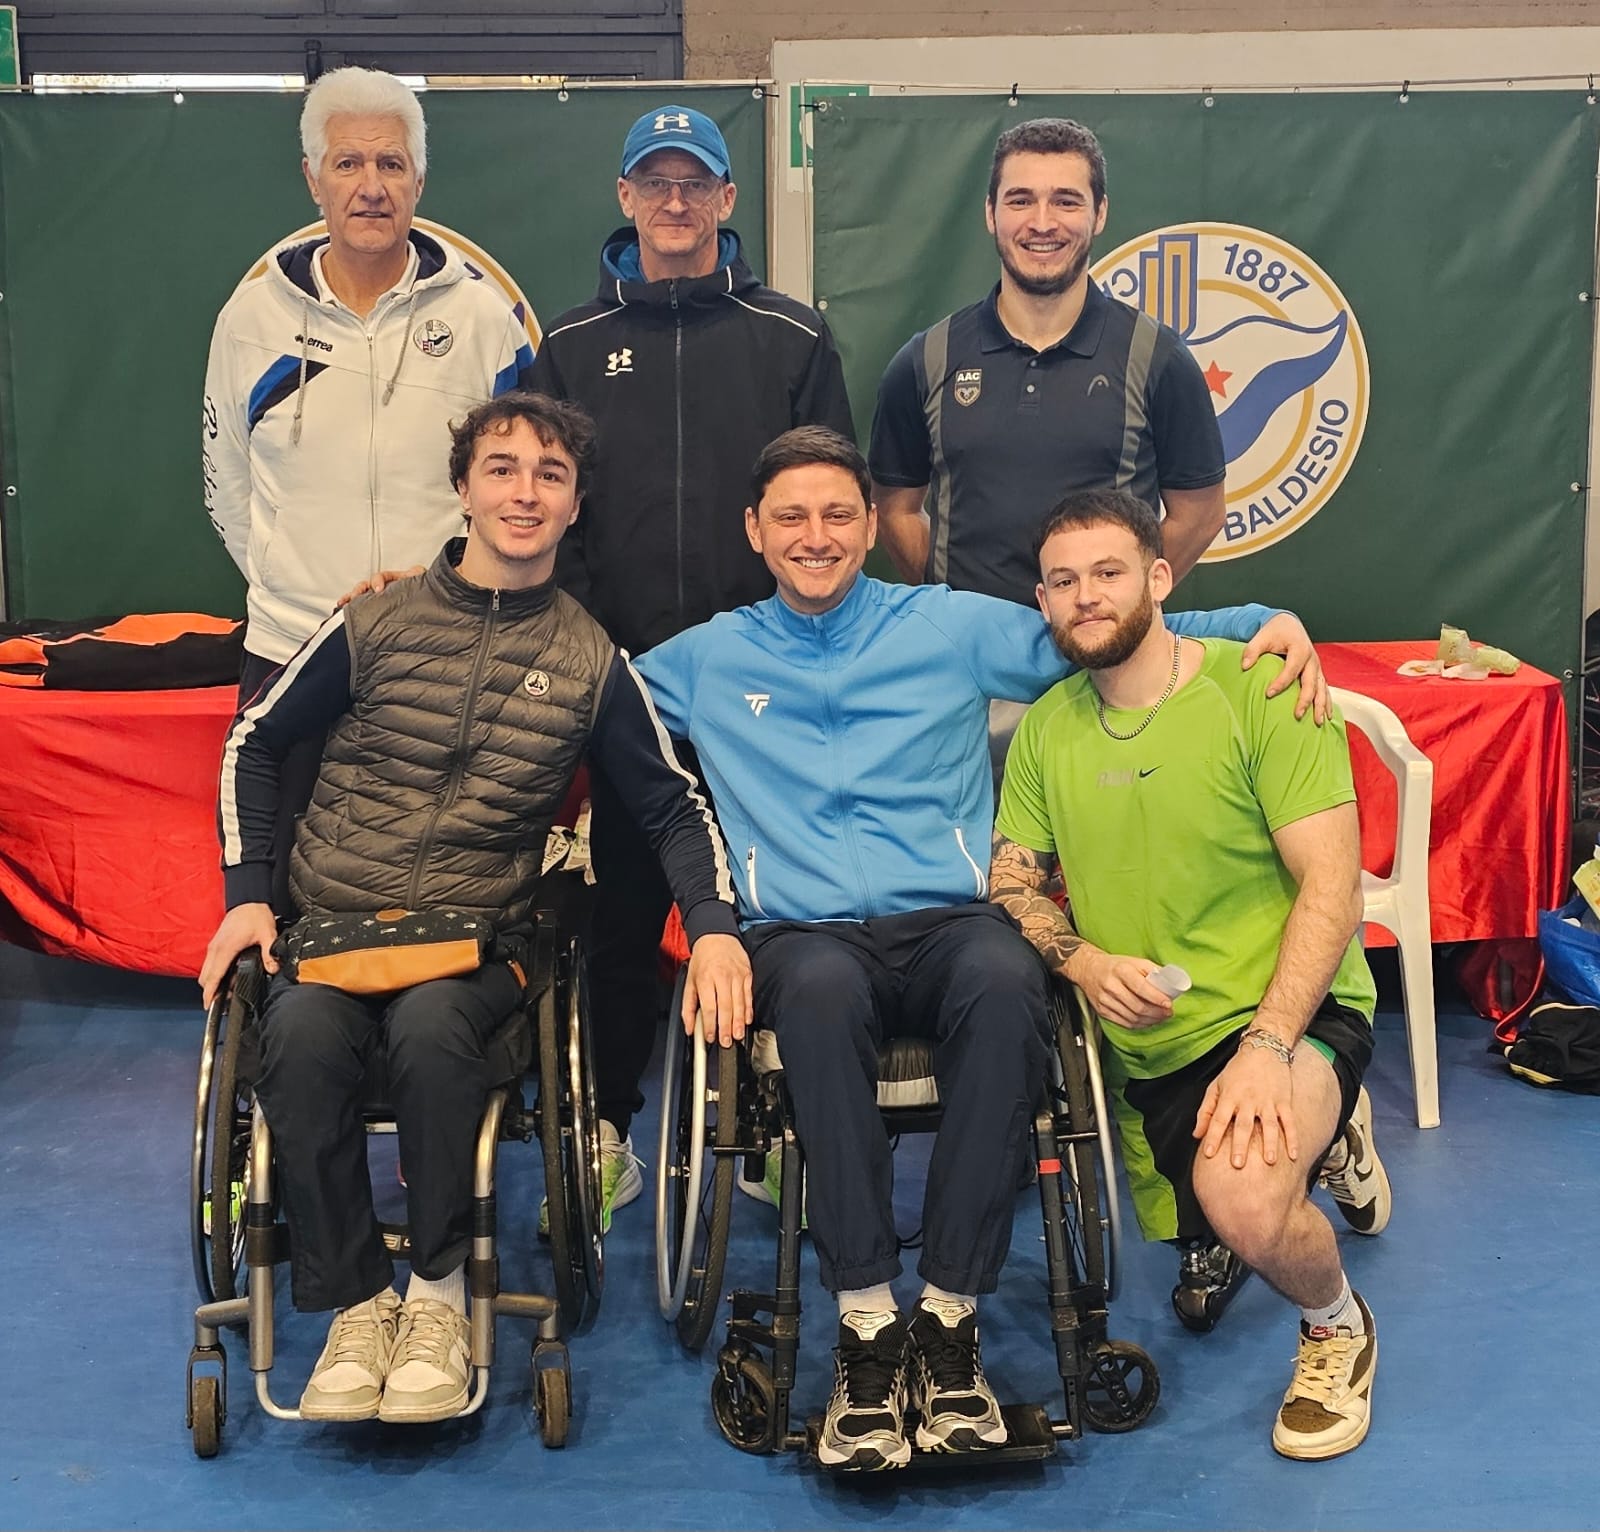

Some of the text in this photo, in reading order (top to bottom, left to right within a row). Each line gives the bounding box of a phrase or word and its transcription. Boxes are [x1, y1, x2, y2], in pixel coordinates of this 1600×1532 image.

[1223, 243, 1310, 302] 1887
[957, 372, 980, 382] AAC
[1223, 399, 1349, 541] BALDESIO
